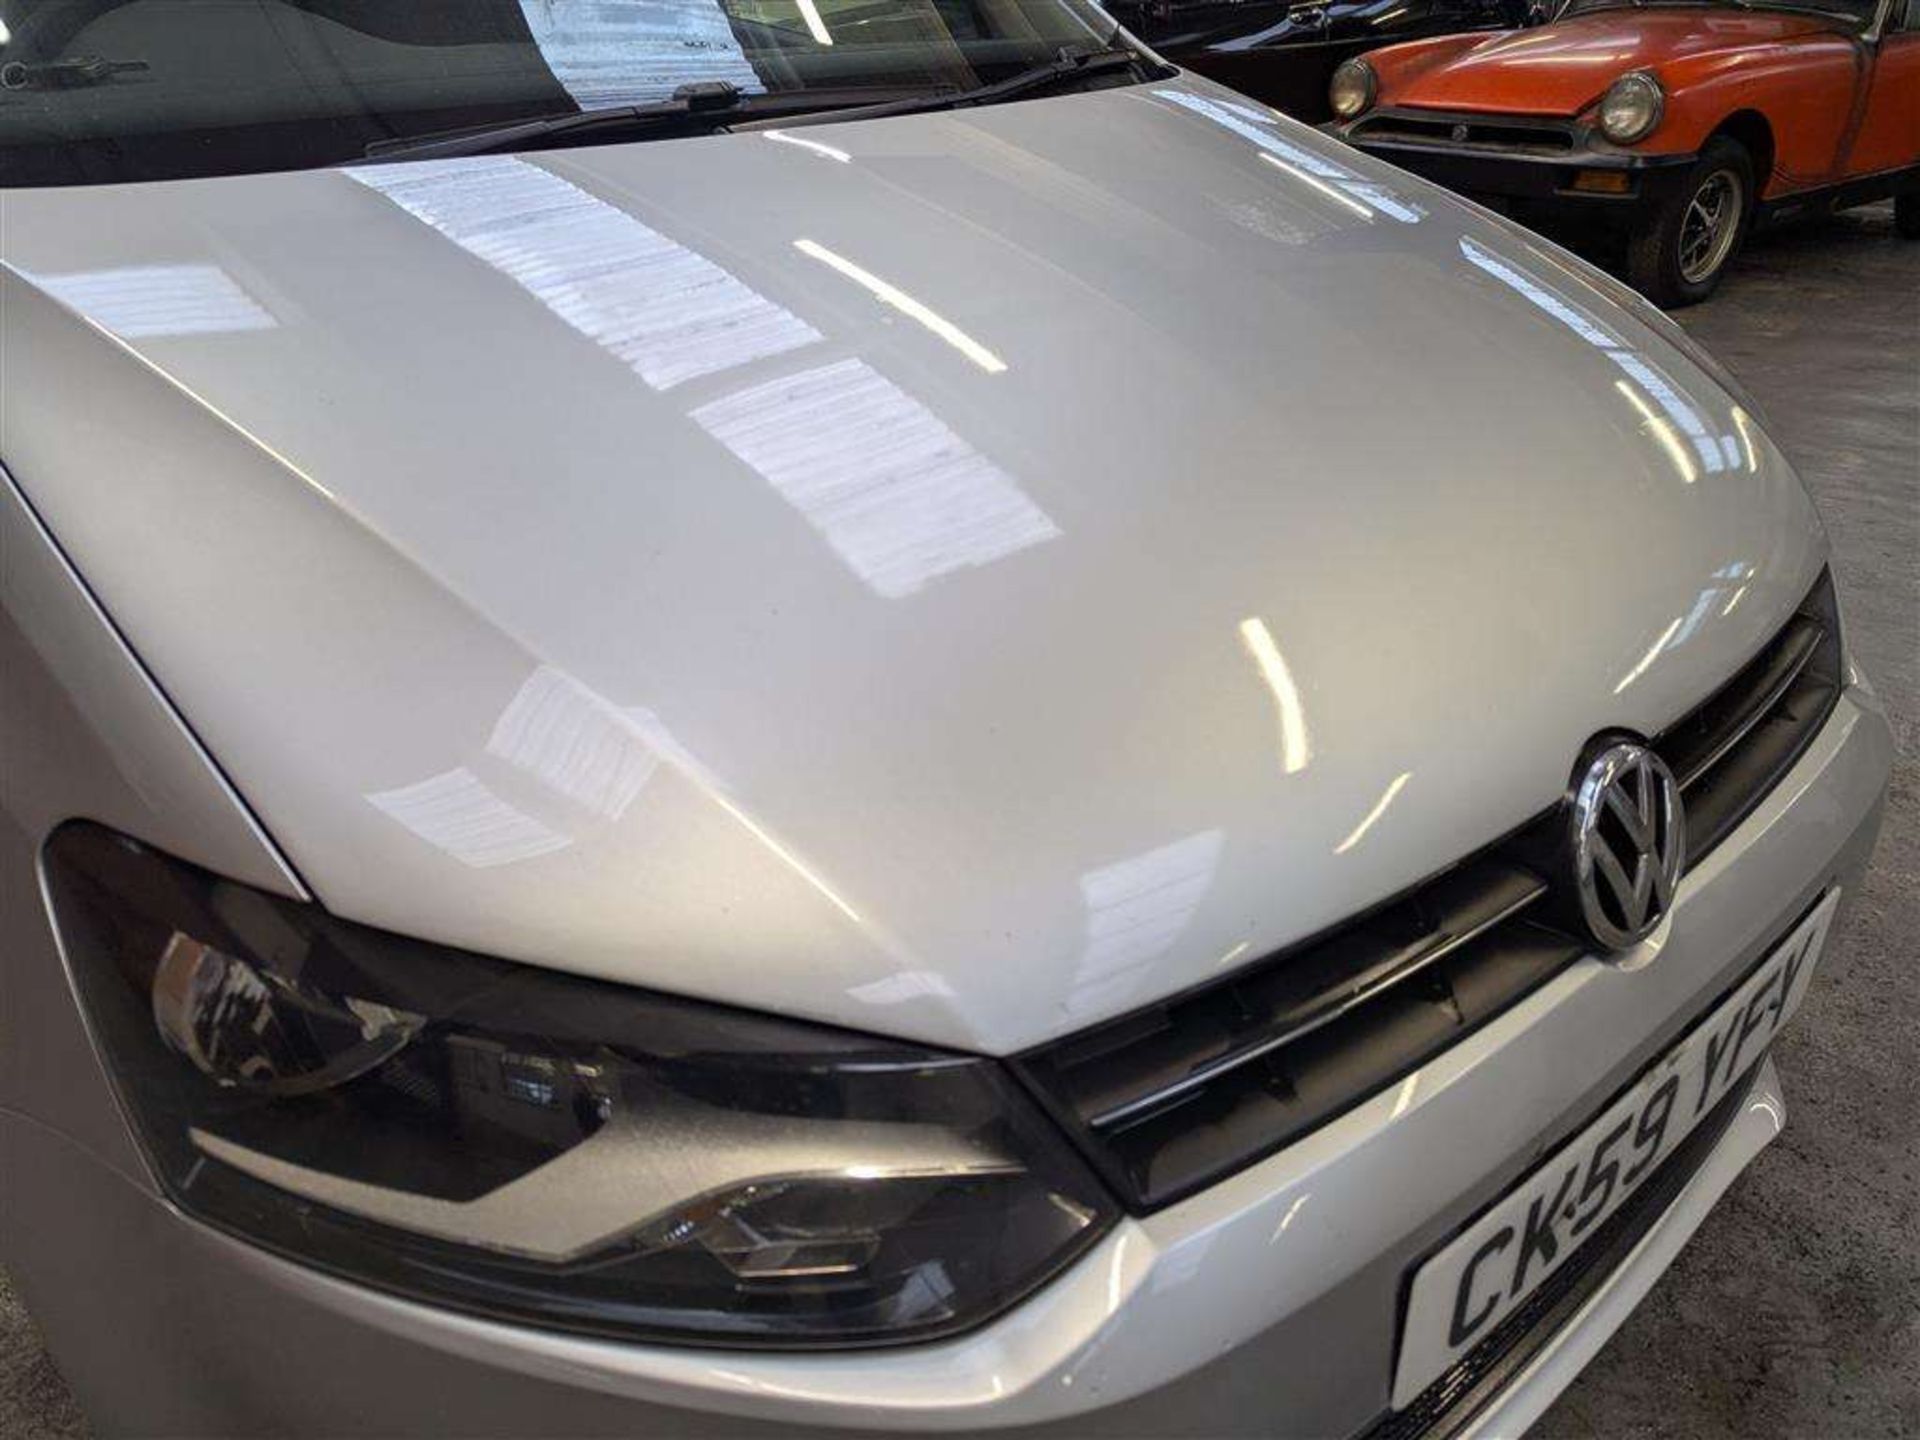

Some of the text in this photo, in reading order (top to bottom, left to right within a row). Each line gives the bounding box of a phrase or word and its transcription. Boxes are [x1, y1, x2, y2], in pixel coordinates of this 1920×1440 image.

[1577, 749, 1679, 941] VW
[1448, 929, 1816, 1348] CK59 YFY
